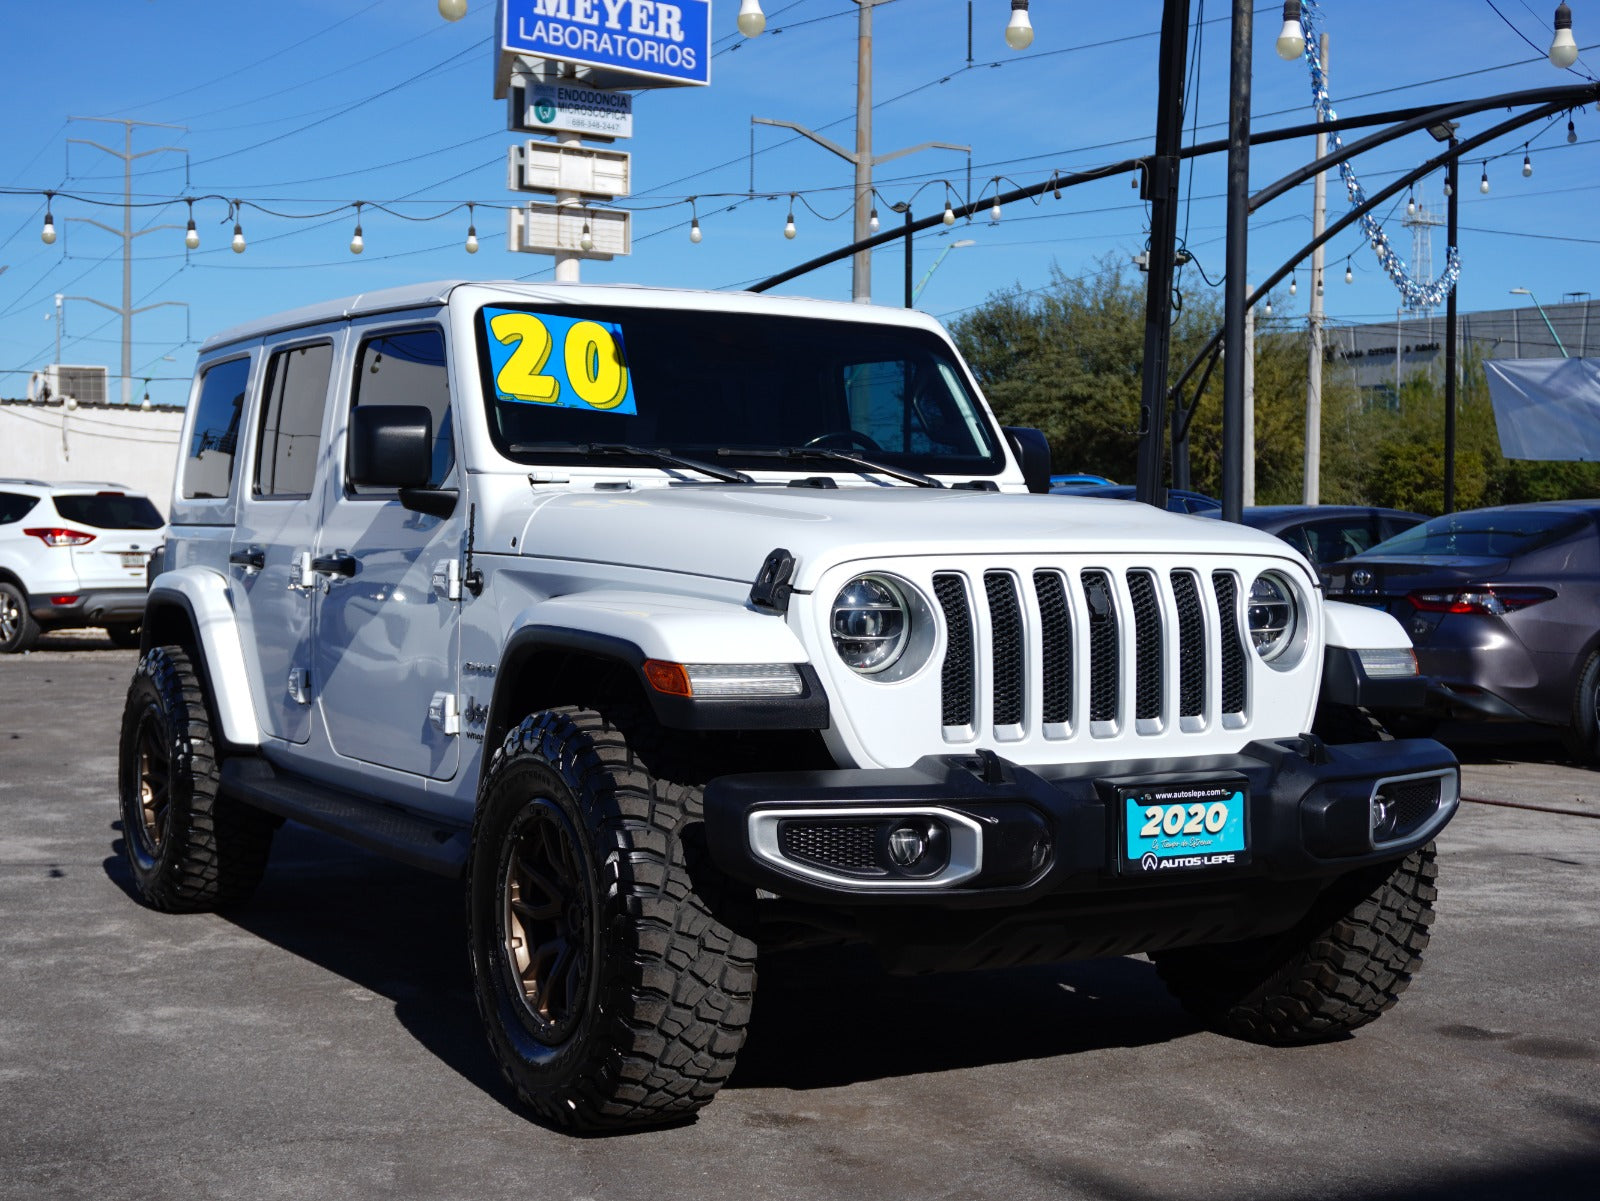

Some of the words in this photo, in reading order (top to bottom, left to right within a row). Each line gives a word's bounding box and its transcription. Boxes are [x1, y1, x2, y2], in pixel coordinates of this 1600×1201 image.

[519, 17, 696, 70] LABORATORIOS
[557, 87, 627, 108] ENDODONCIA
[488, 311, 629, 410] 20
[1155, 788, 1221, 800] www.autoslepe.com
[1139, 802, 1229, 837] 2020
